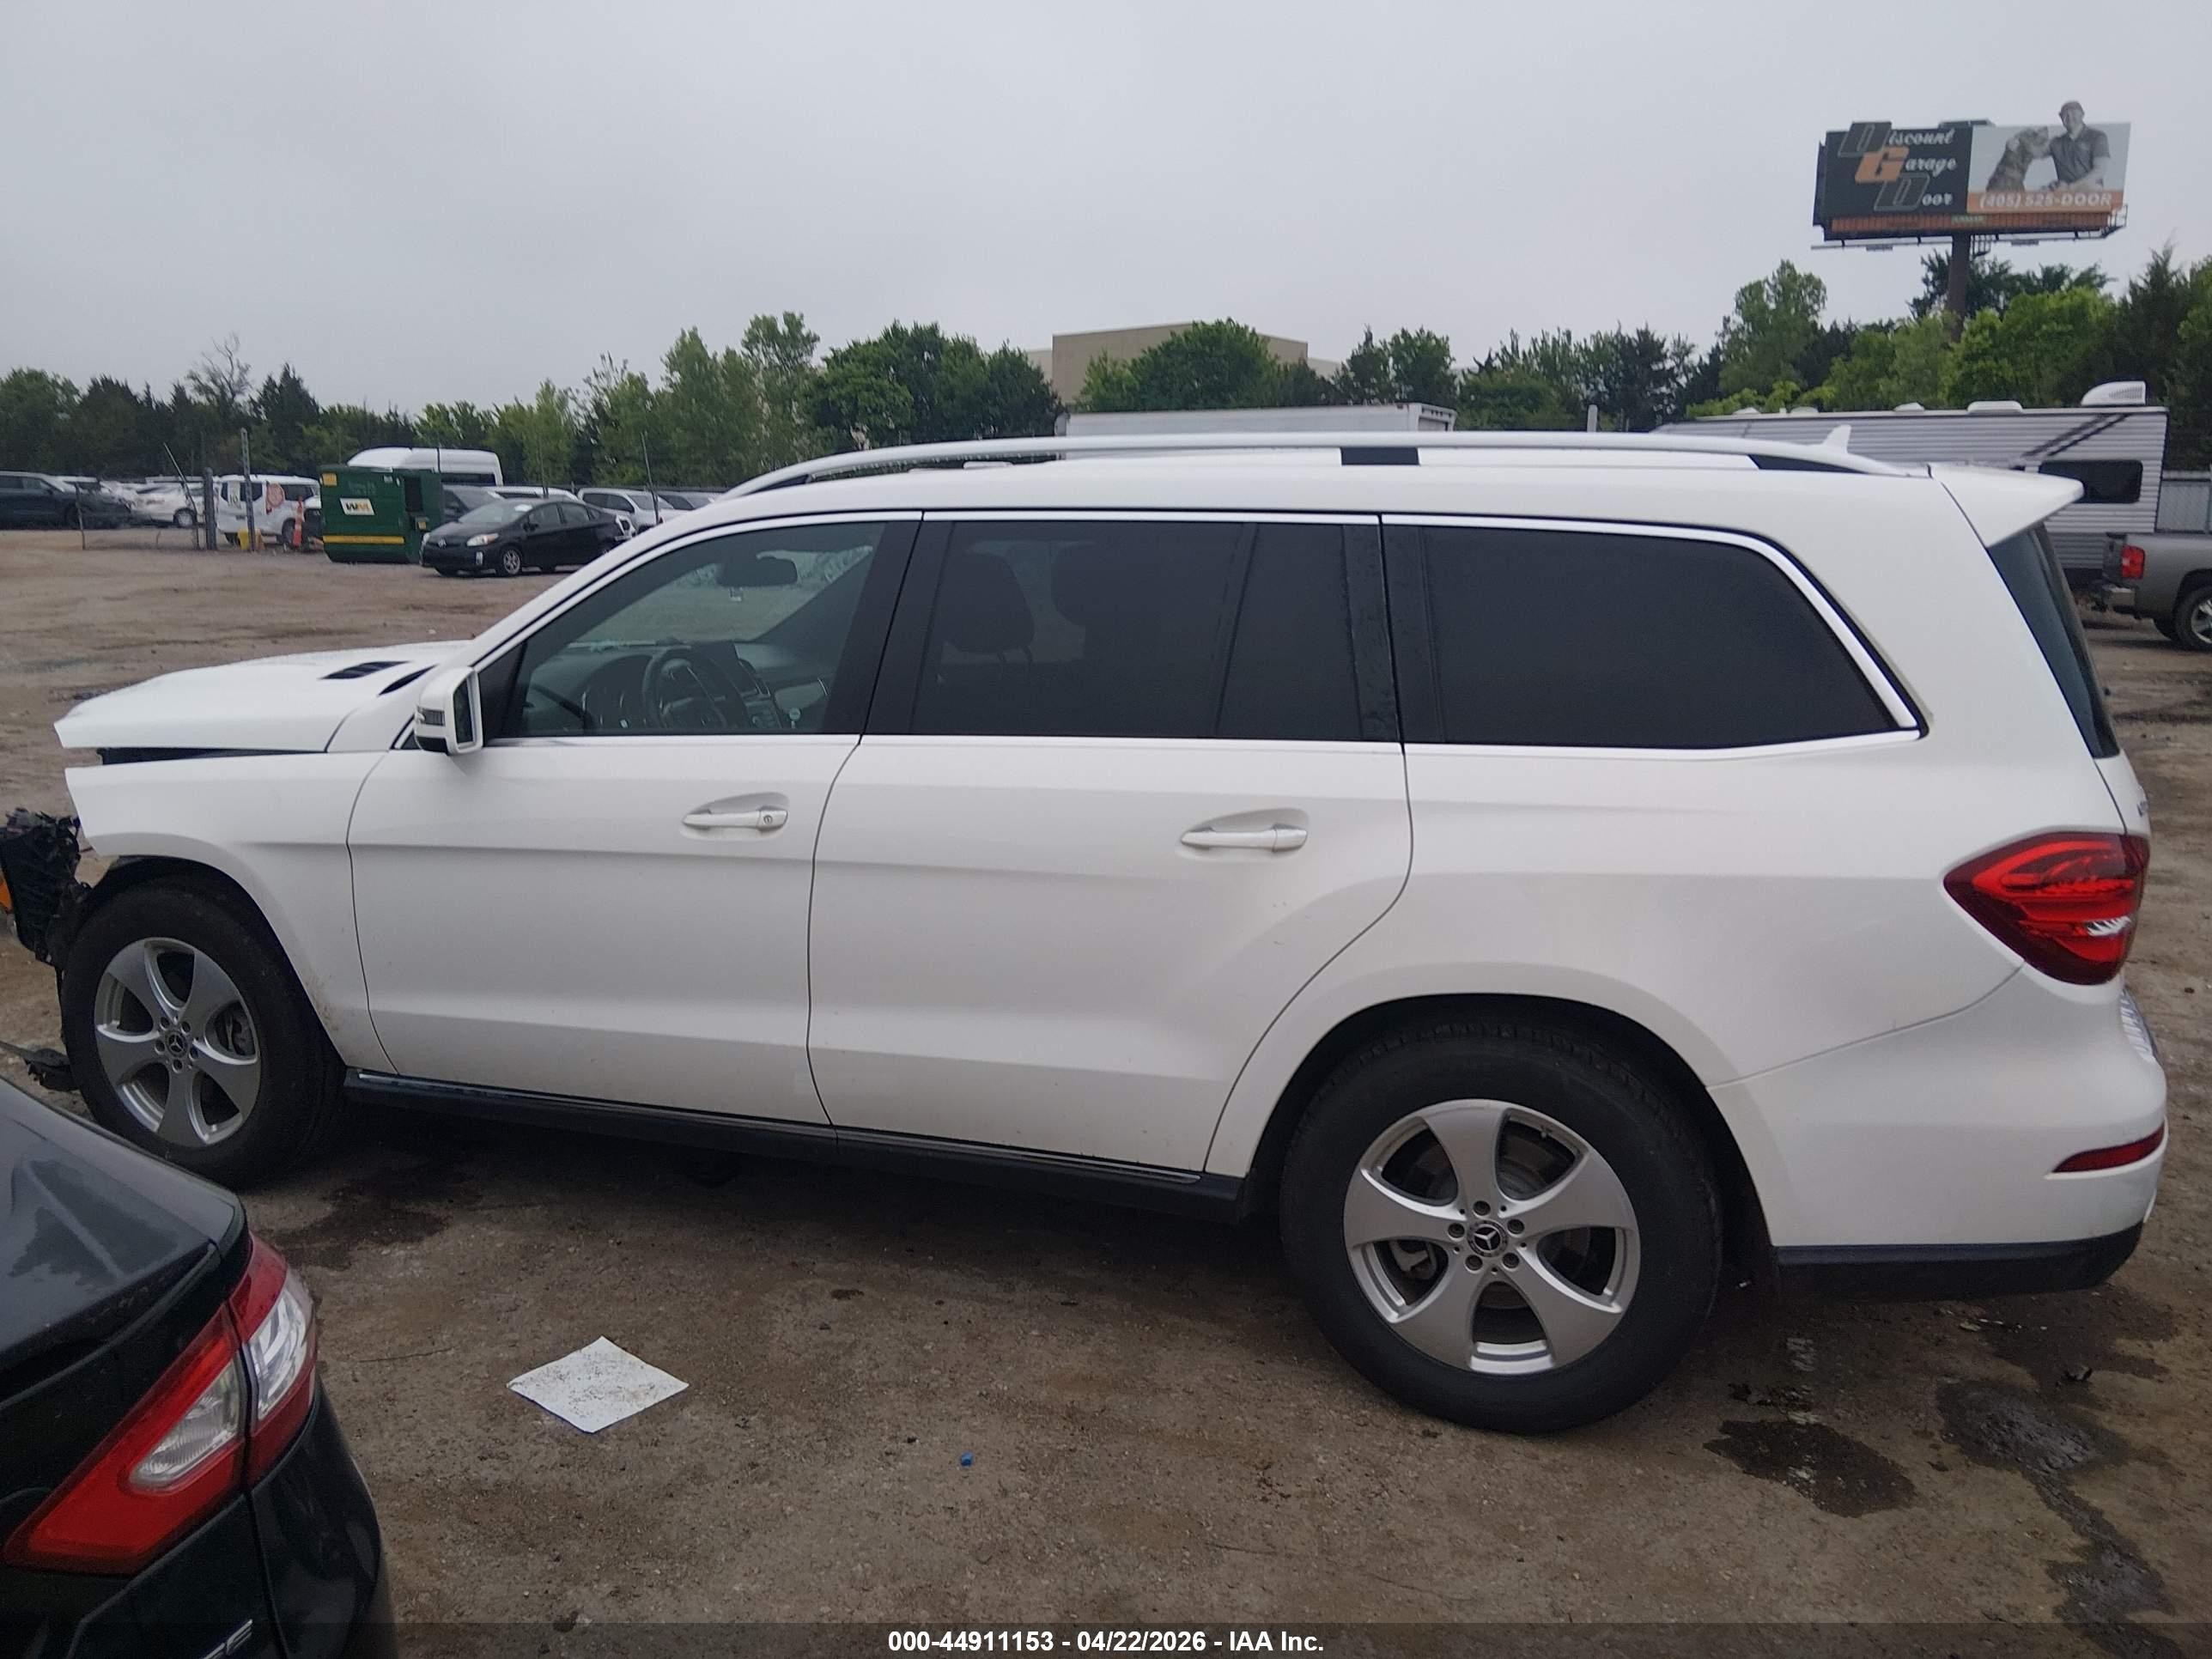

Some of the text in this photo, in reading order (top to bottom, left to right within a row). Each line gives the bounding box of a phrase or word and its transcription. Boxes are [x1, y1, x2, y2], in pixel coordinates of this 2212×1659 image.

[1838, 122, 1955, 158] Discount
[1854, 146, 1957, 184] Garage
[1874, 173, 1954, 211] Door
[345, 502, 371, 513] WM
